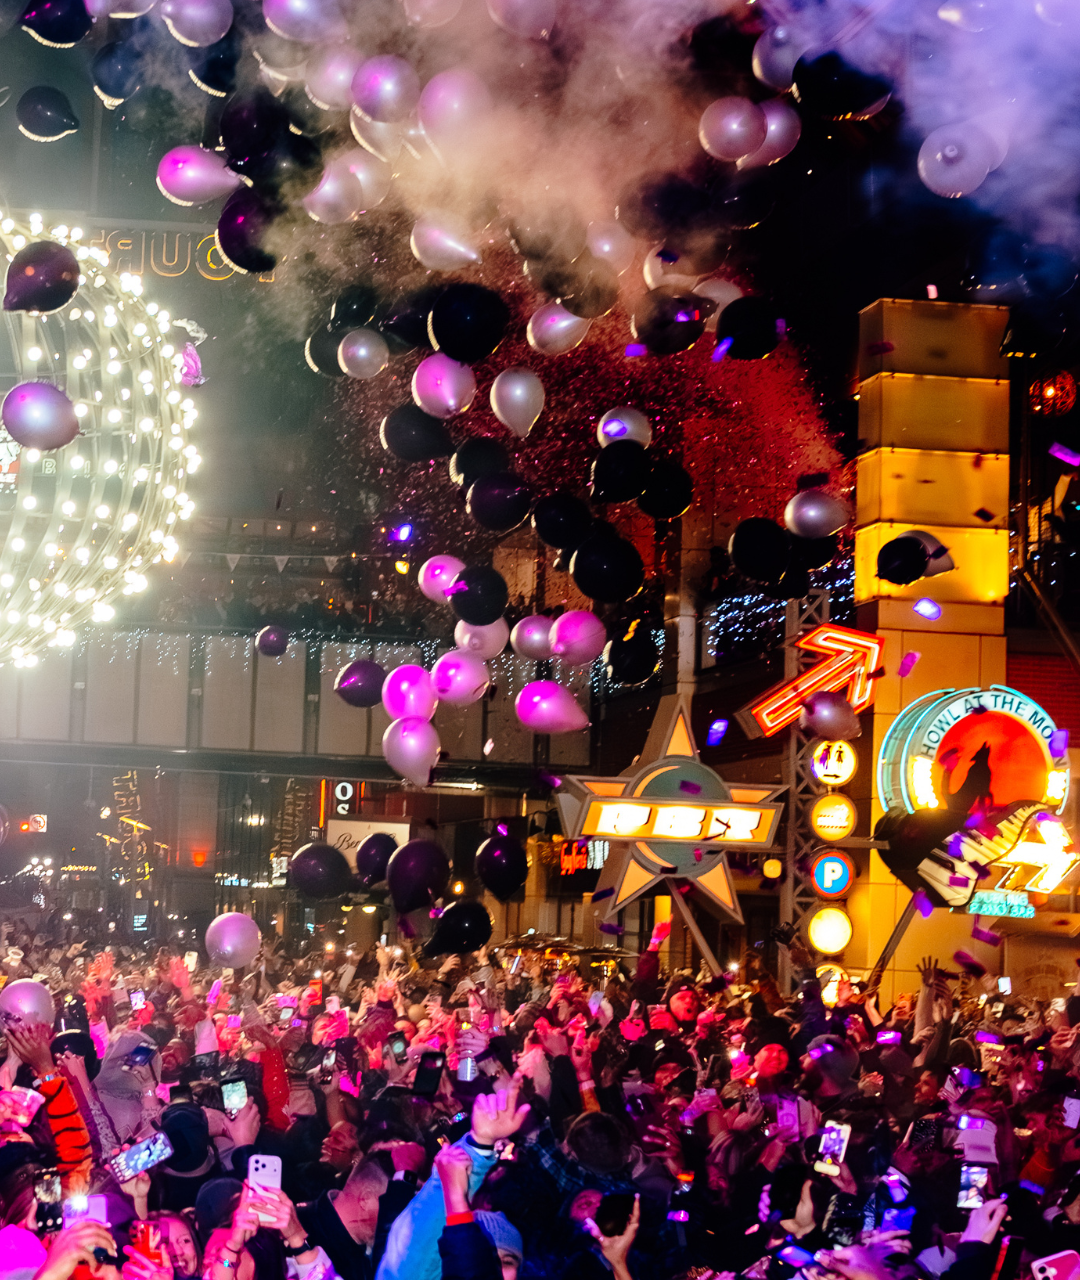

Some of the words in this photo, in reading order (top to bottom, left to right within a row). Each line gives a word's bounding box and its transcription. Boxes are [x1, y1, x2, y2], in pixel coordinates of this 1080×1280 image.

[921, 708, 961, 759] HOWL
[964, 694, 984, 714] AT
[990, 694, 1029, 717] THE
[1028, 711, 1068, 768] MON
[824, 862, 843, 888] P
[974, 891, 1029, 907] DUELING
[968, 902, 1008, 916] PIANO
[1009, 905, 1035, 918] BAR
